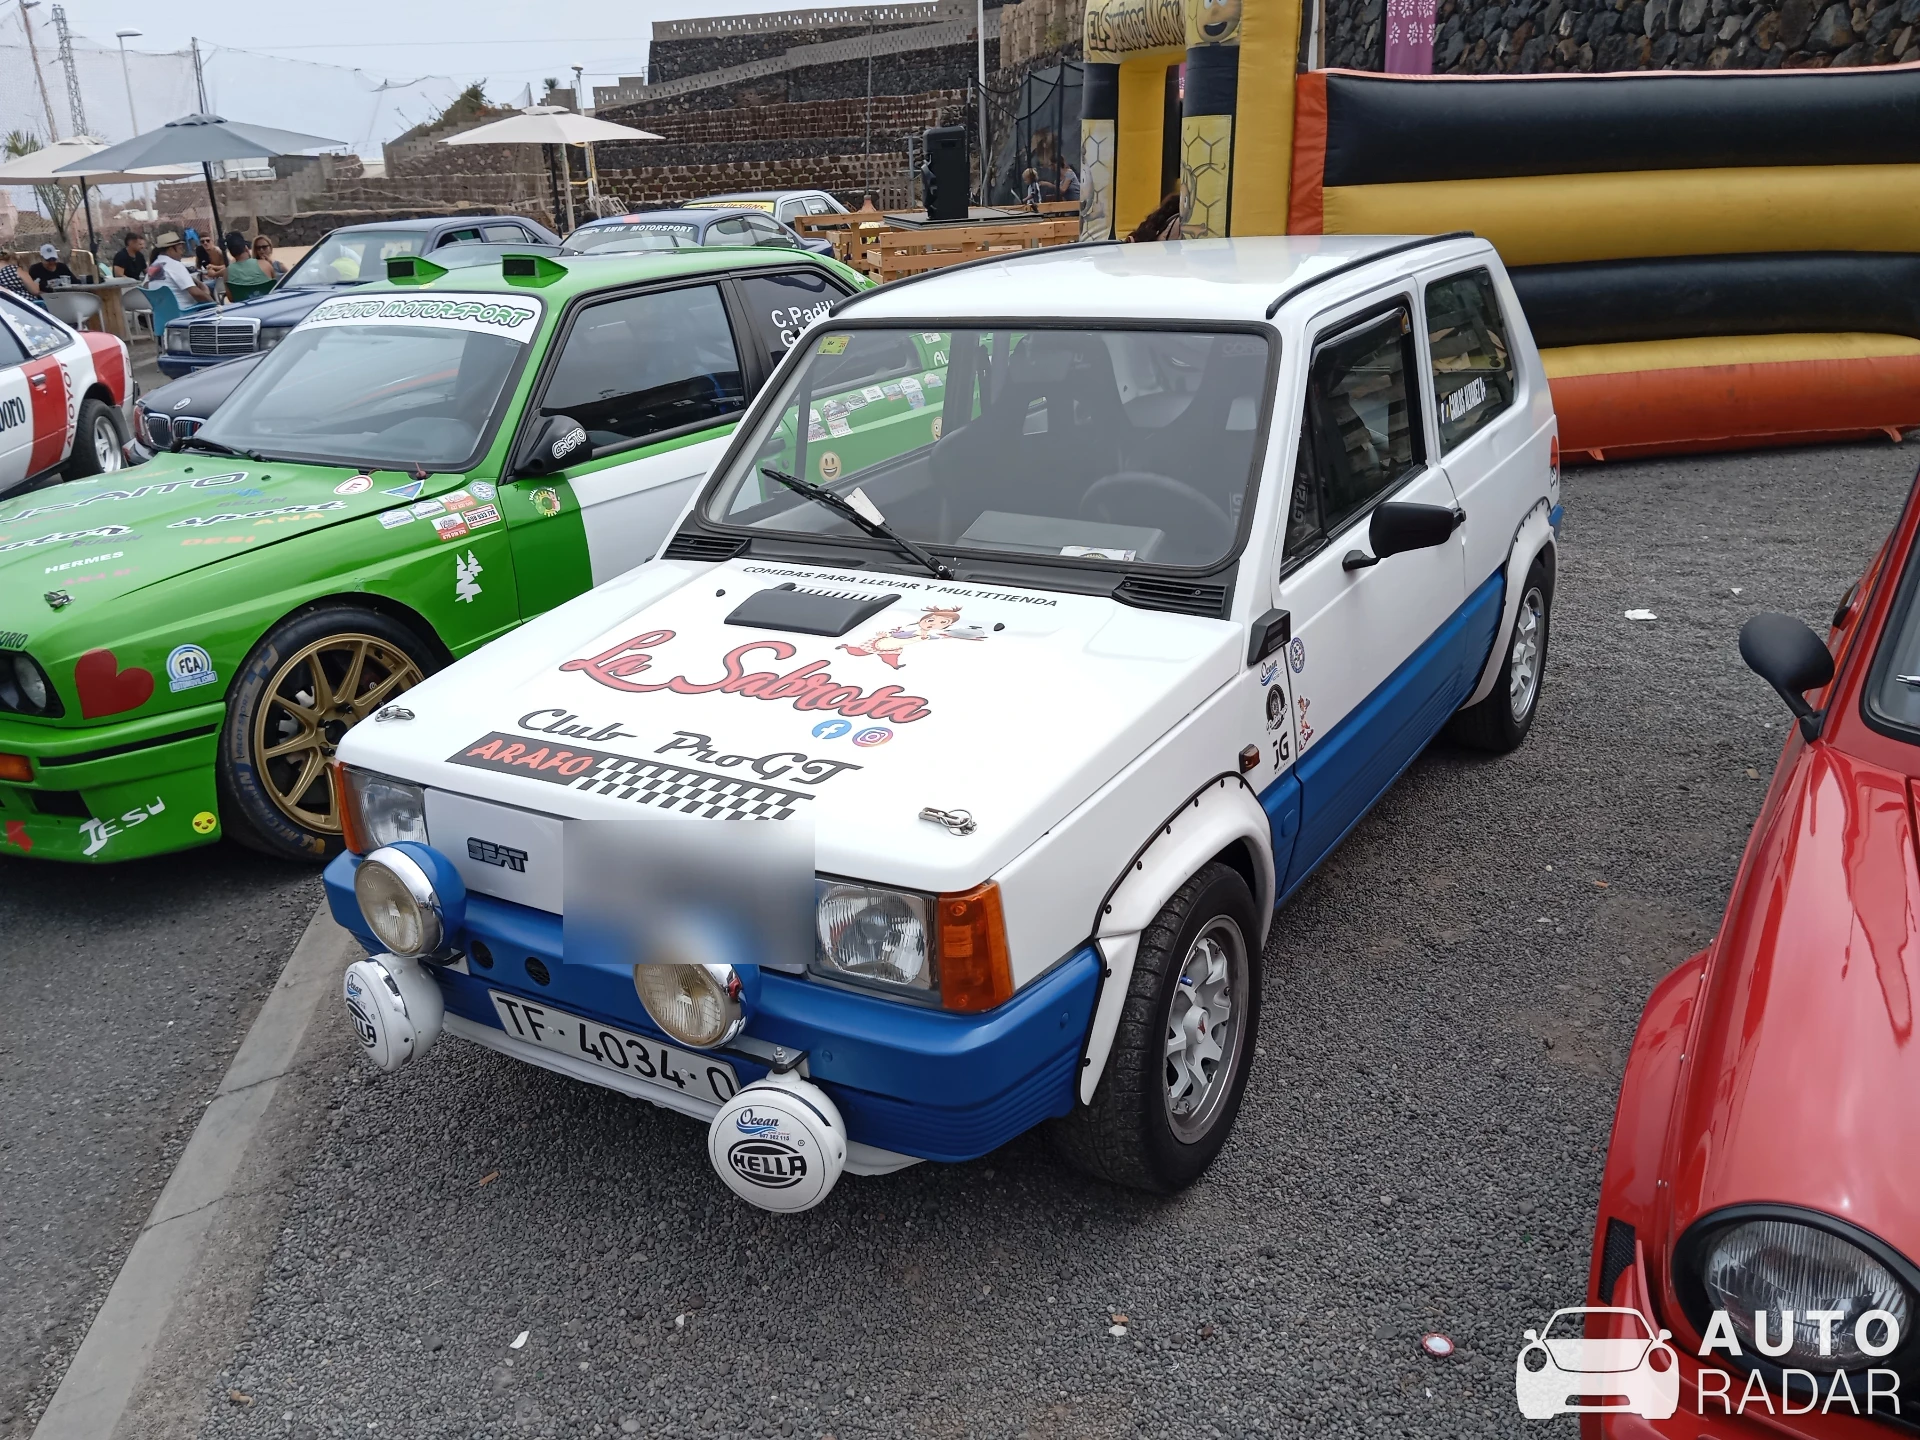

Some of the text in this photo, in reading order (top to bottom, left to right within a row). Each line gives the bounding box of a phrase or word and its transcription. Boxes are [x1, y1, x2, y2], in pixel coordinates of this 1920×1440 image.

[603, 225, 627, 234] BMW
[631, 224, 693, 234] MOTORSPORT
[379, 299, 535, 328] MOTORSPORT
[552, 427, 587, 460] CRISTO
[252, 512, 325, 527] ANA
[179, 535, 257, 547] DESI
[44, 550, 125, 575] HERMES
[743, 565, 811, 579] COMIDAS
[813, 572, 856, 584] PARA
[858, 577, 920, 591] LLEVAR
[937, 585, 1058, 608] MULTITIENDA
[178, 656, 201, 674] FCA
[558, 629, 932, 724] La Sabrosa
[466, 739, 597, 779] ARAFO
[517, 708, 865, 786] Club ProGT
[467, 836, 529, 873] SEAT
[739, 1107, 780, 1128] Ocean
[733, 1153, 808, 1177] HELLA
